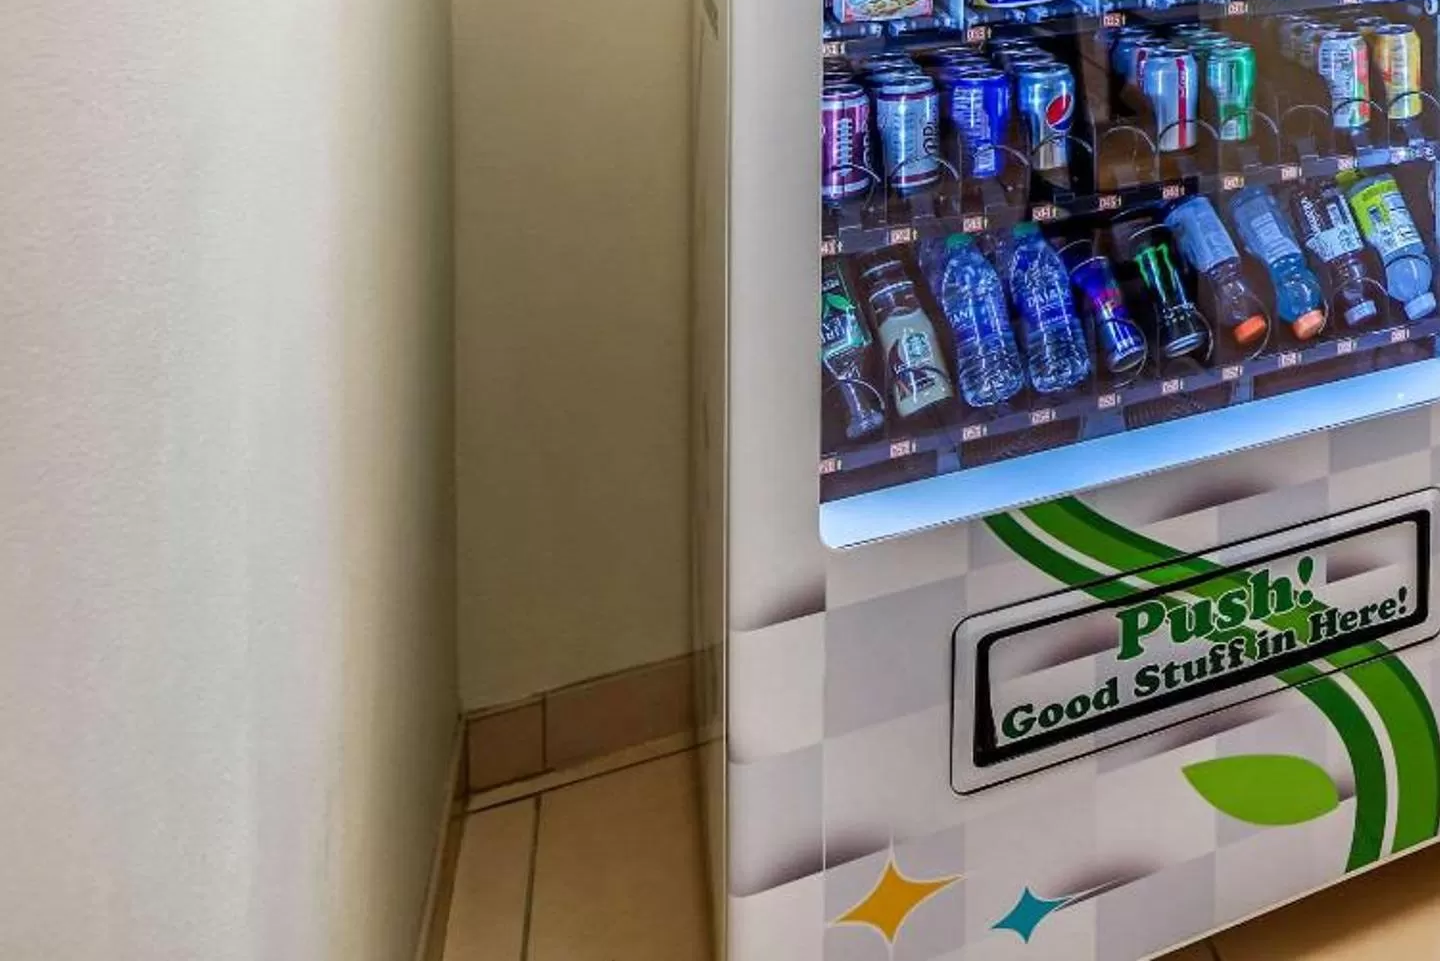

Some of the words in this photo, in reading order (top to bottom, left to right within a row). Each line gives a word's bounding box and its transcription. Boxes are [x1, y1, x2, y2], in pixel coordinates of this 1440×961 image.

[1001, 677, 1119, 739] Good
[1133, 639, 1246, 698] Stuff
[1256, 627, 1296, 659] in
[1308, 586, 1409, 643] Here!
[1115, 555, 1314, 661] Push!
